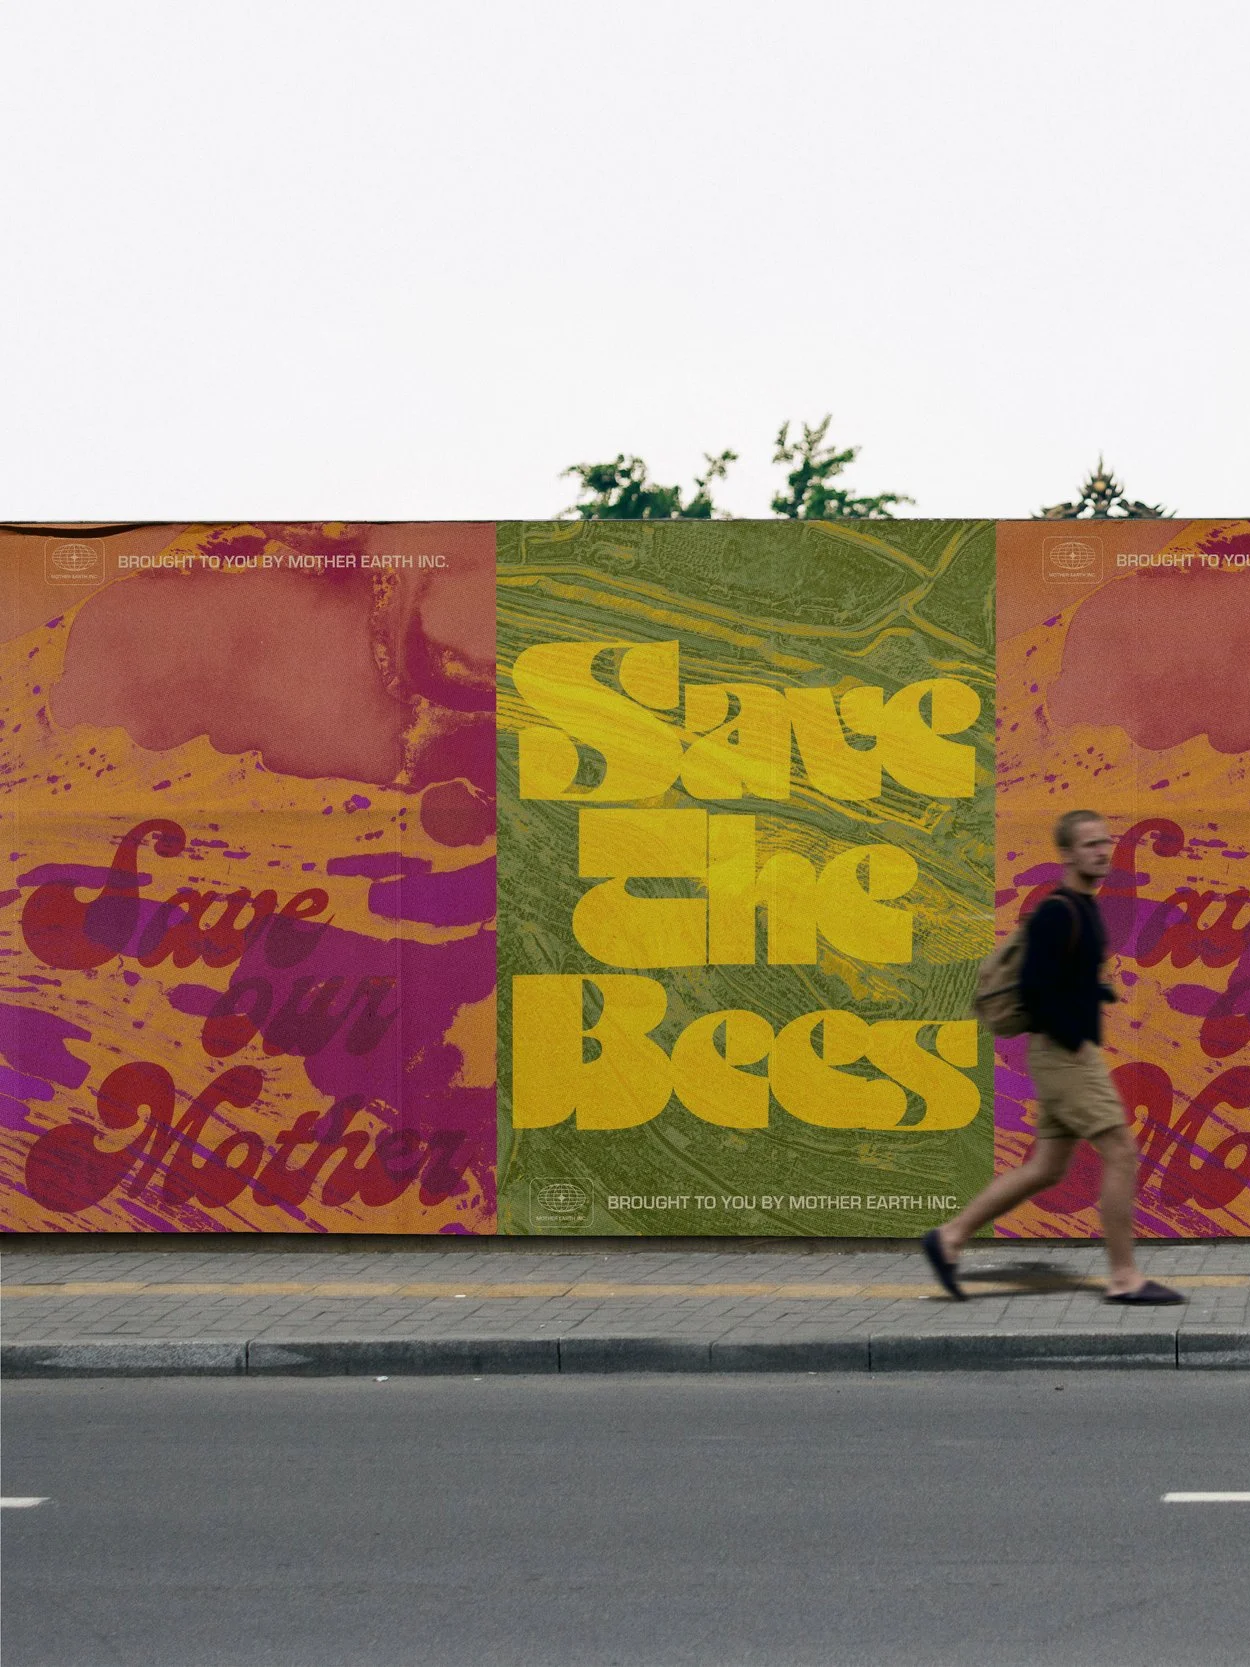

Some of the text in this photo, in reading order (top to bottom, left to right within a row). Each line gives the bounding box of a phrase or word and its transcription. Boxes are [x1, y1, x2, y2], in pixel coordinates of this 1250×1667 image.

[118, 555, 449, 568] BROUGHT TO YOU BY MOTHER EARTH INC.
[1116, 554, 1194, 567] BROUGHT
[1199, 554, 1220, 567] TO
[512, 640, 981, 800] Save
[21, 818, 335, 970] Save
[202, 976, 400, 1057] our
[512, 974, 981, 1130] Bees
[25, 1061, 472, 1213] Mother
[608, 1195, 960, 1210] BROUGHT TO YOU BY MOTHER EARTH INC.
